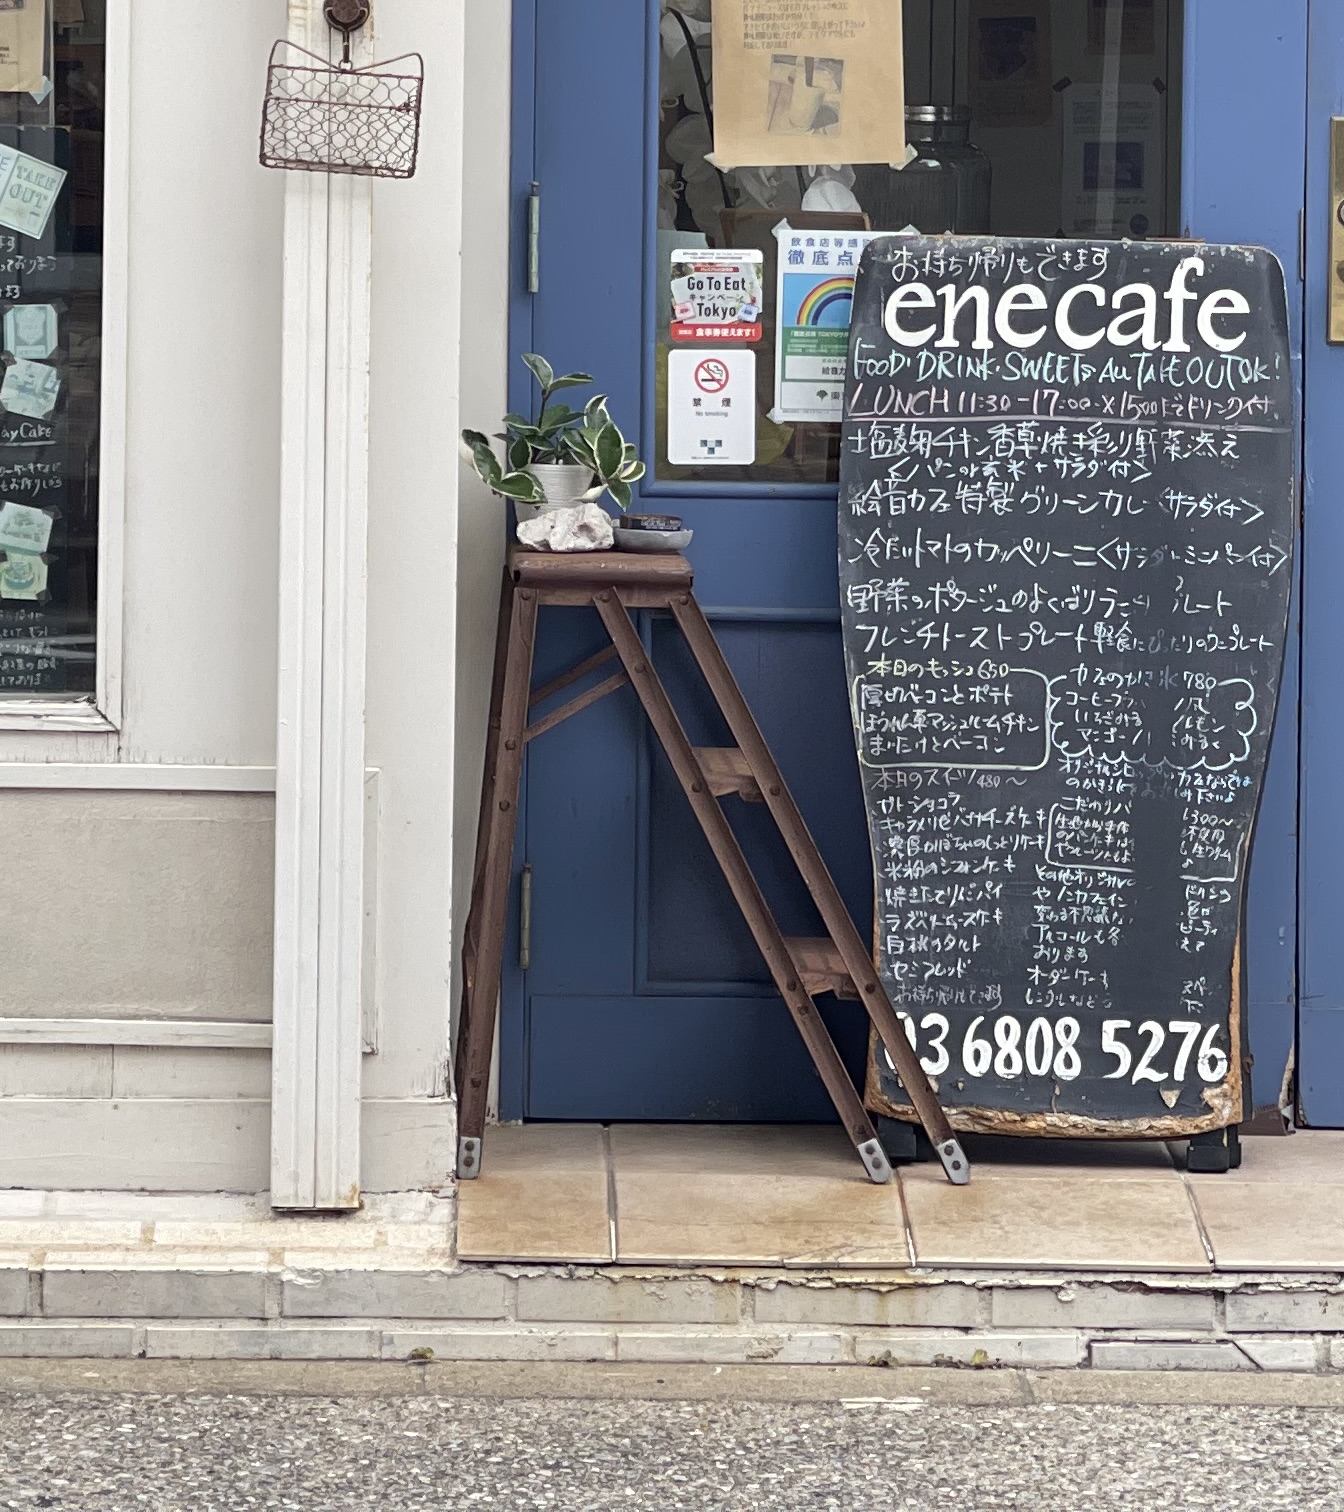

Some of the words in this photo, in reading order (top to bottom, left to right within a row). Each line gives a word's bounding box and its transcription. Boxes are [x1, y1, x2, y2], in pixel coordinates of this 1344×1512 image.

[9, 183, 48, 210] OUT
[687, 276, 704, 290] Go
[706, 276, 721, 290] To
[724, 276, 746, 290] Eat
[696, 303, 736, 320] Tokyo
[884, 256, 1251, 353] enecafe
[848, 383, 950, 417] LUNCH
[962, 1015, 1082, 1080] 6808
[1102, 1019, 1228, 1086] 5276
